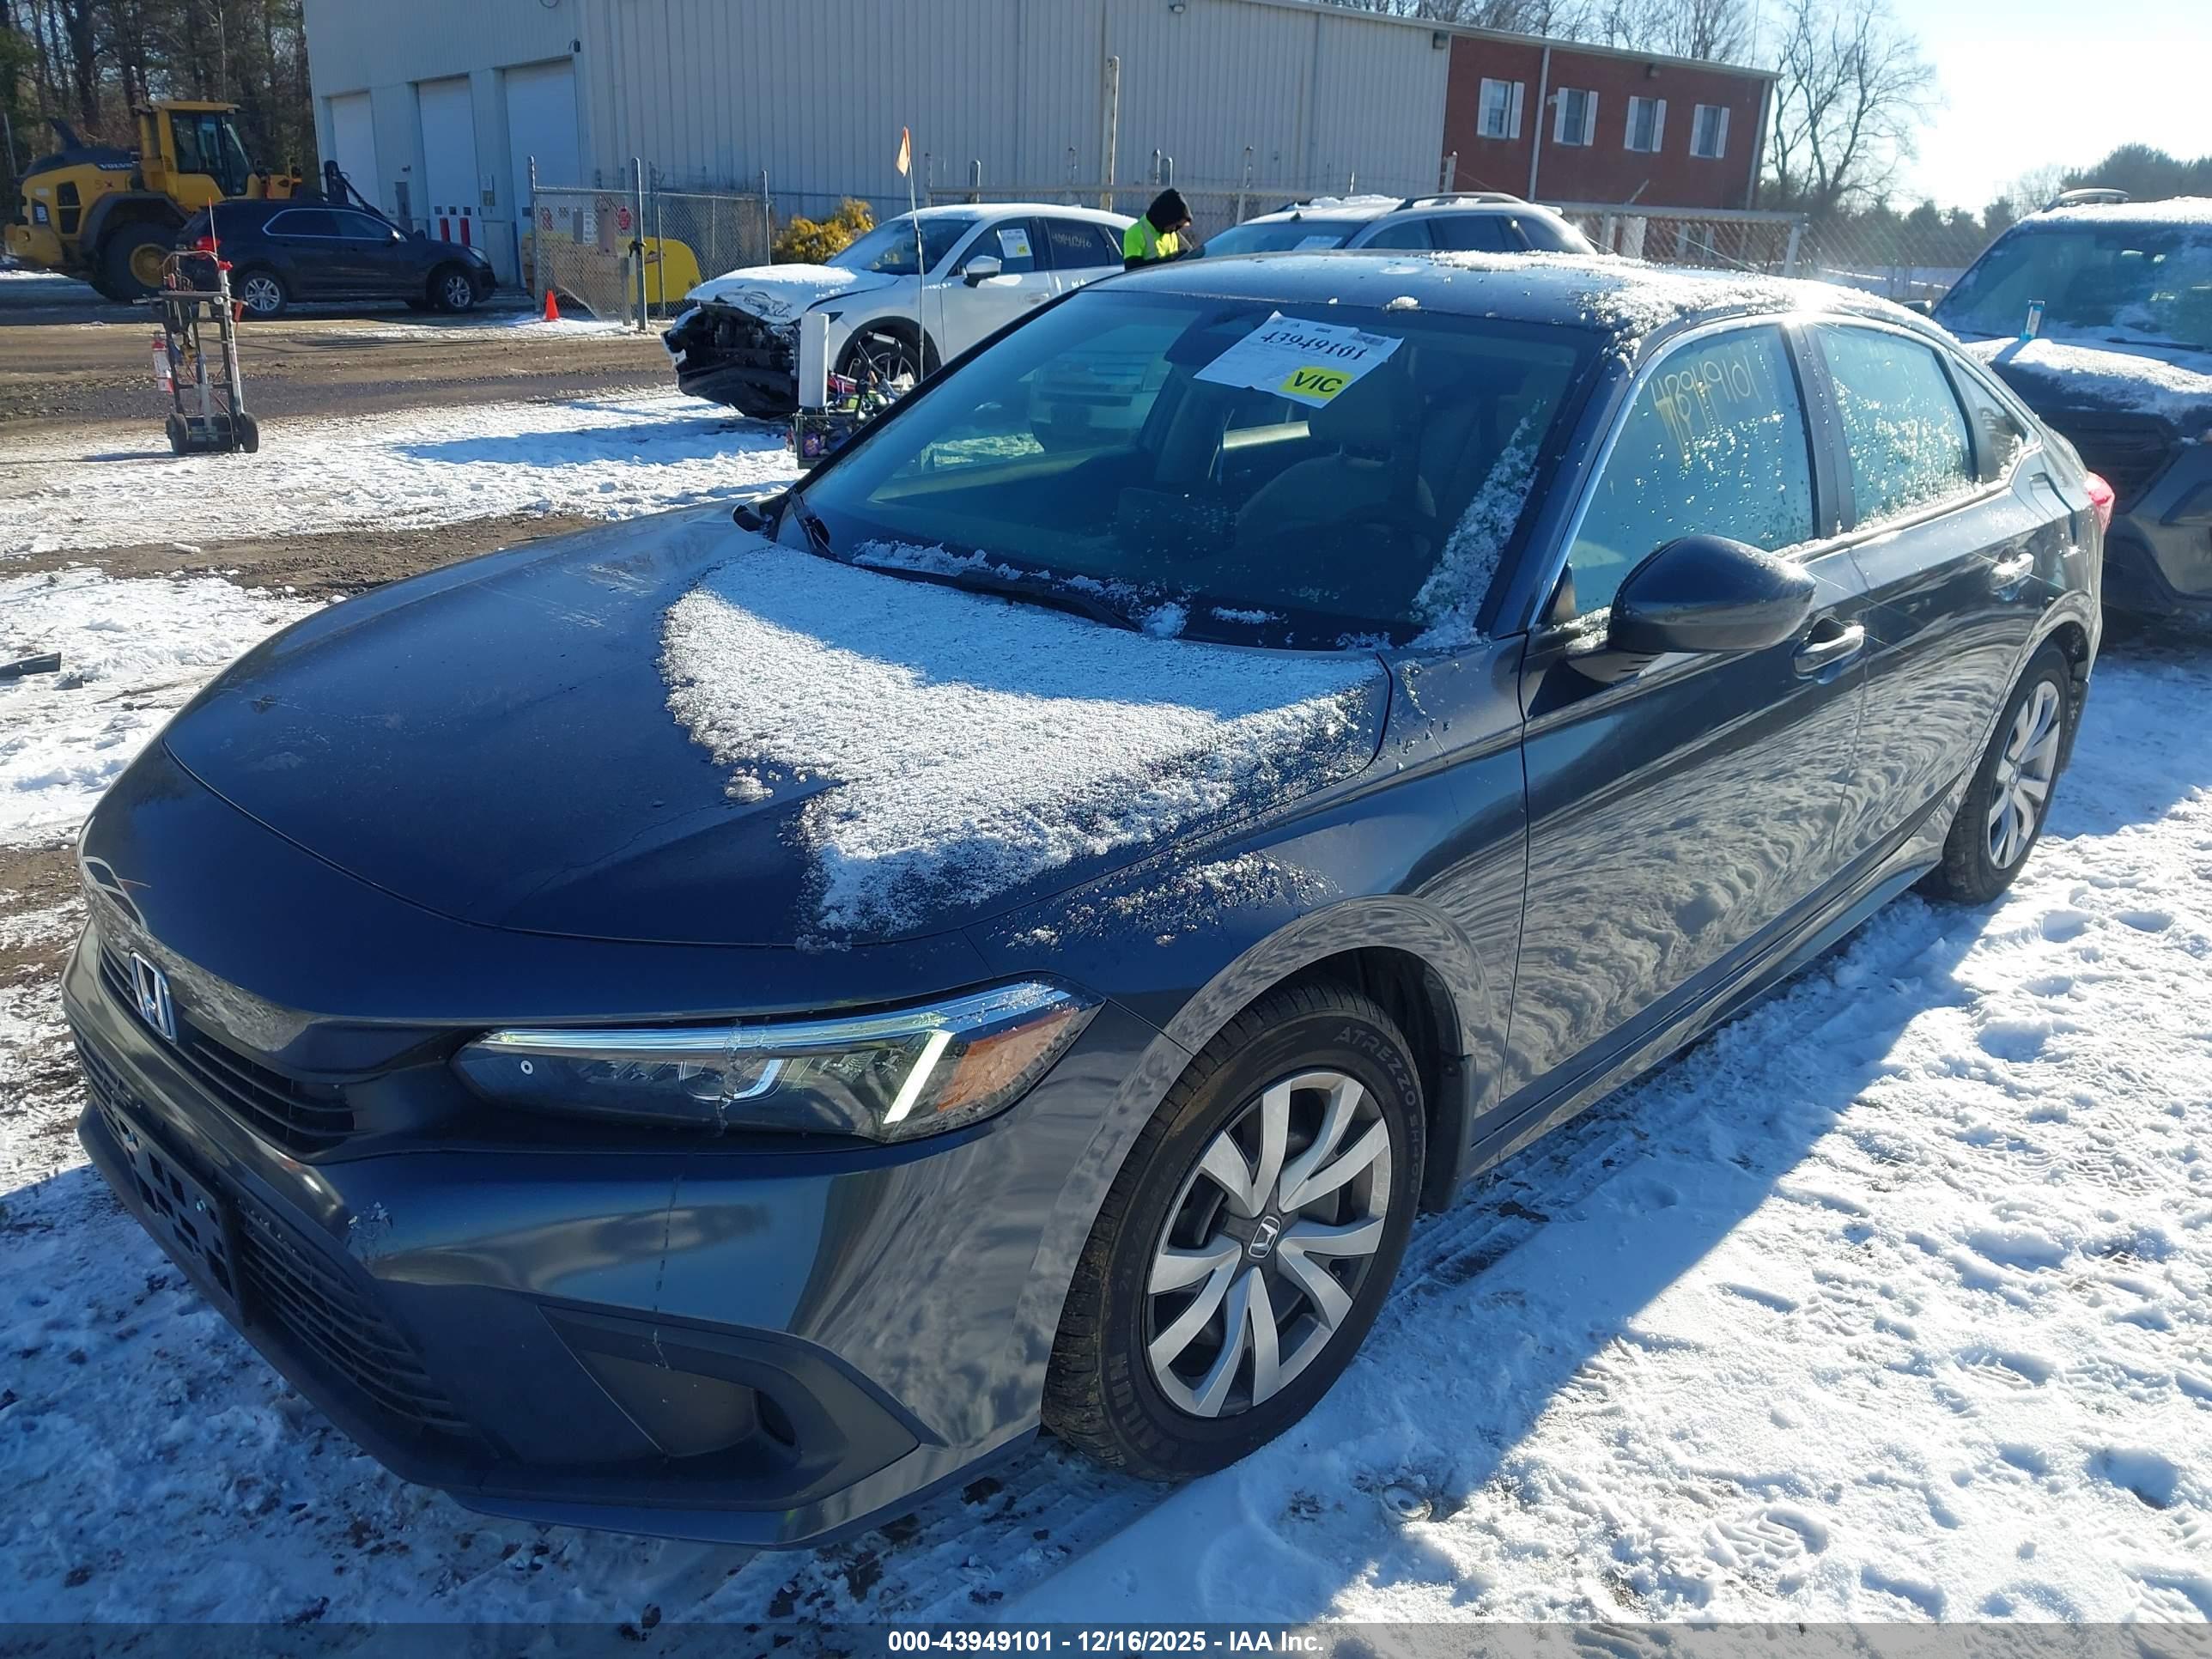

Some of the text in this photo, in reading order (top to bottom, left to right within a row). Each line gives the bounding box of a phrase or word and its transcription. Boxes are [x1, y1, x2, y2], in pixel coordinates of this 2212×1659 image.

[1261, 331, 1369, 361] 43949101
[1293, 370, 1343, 393] VIC
[1650, 355, 1762, 431] 43949101
[1333, 1026, 1417, 1107] ATREZZO
